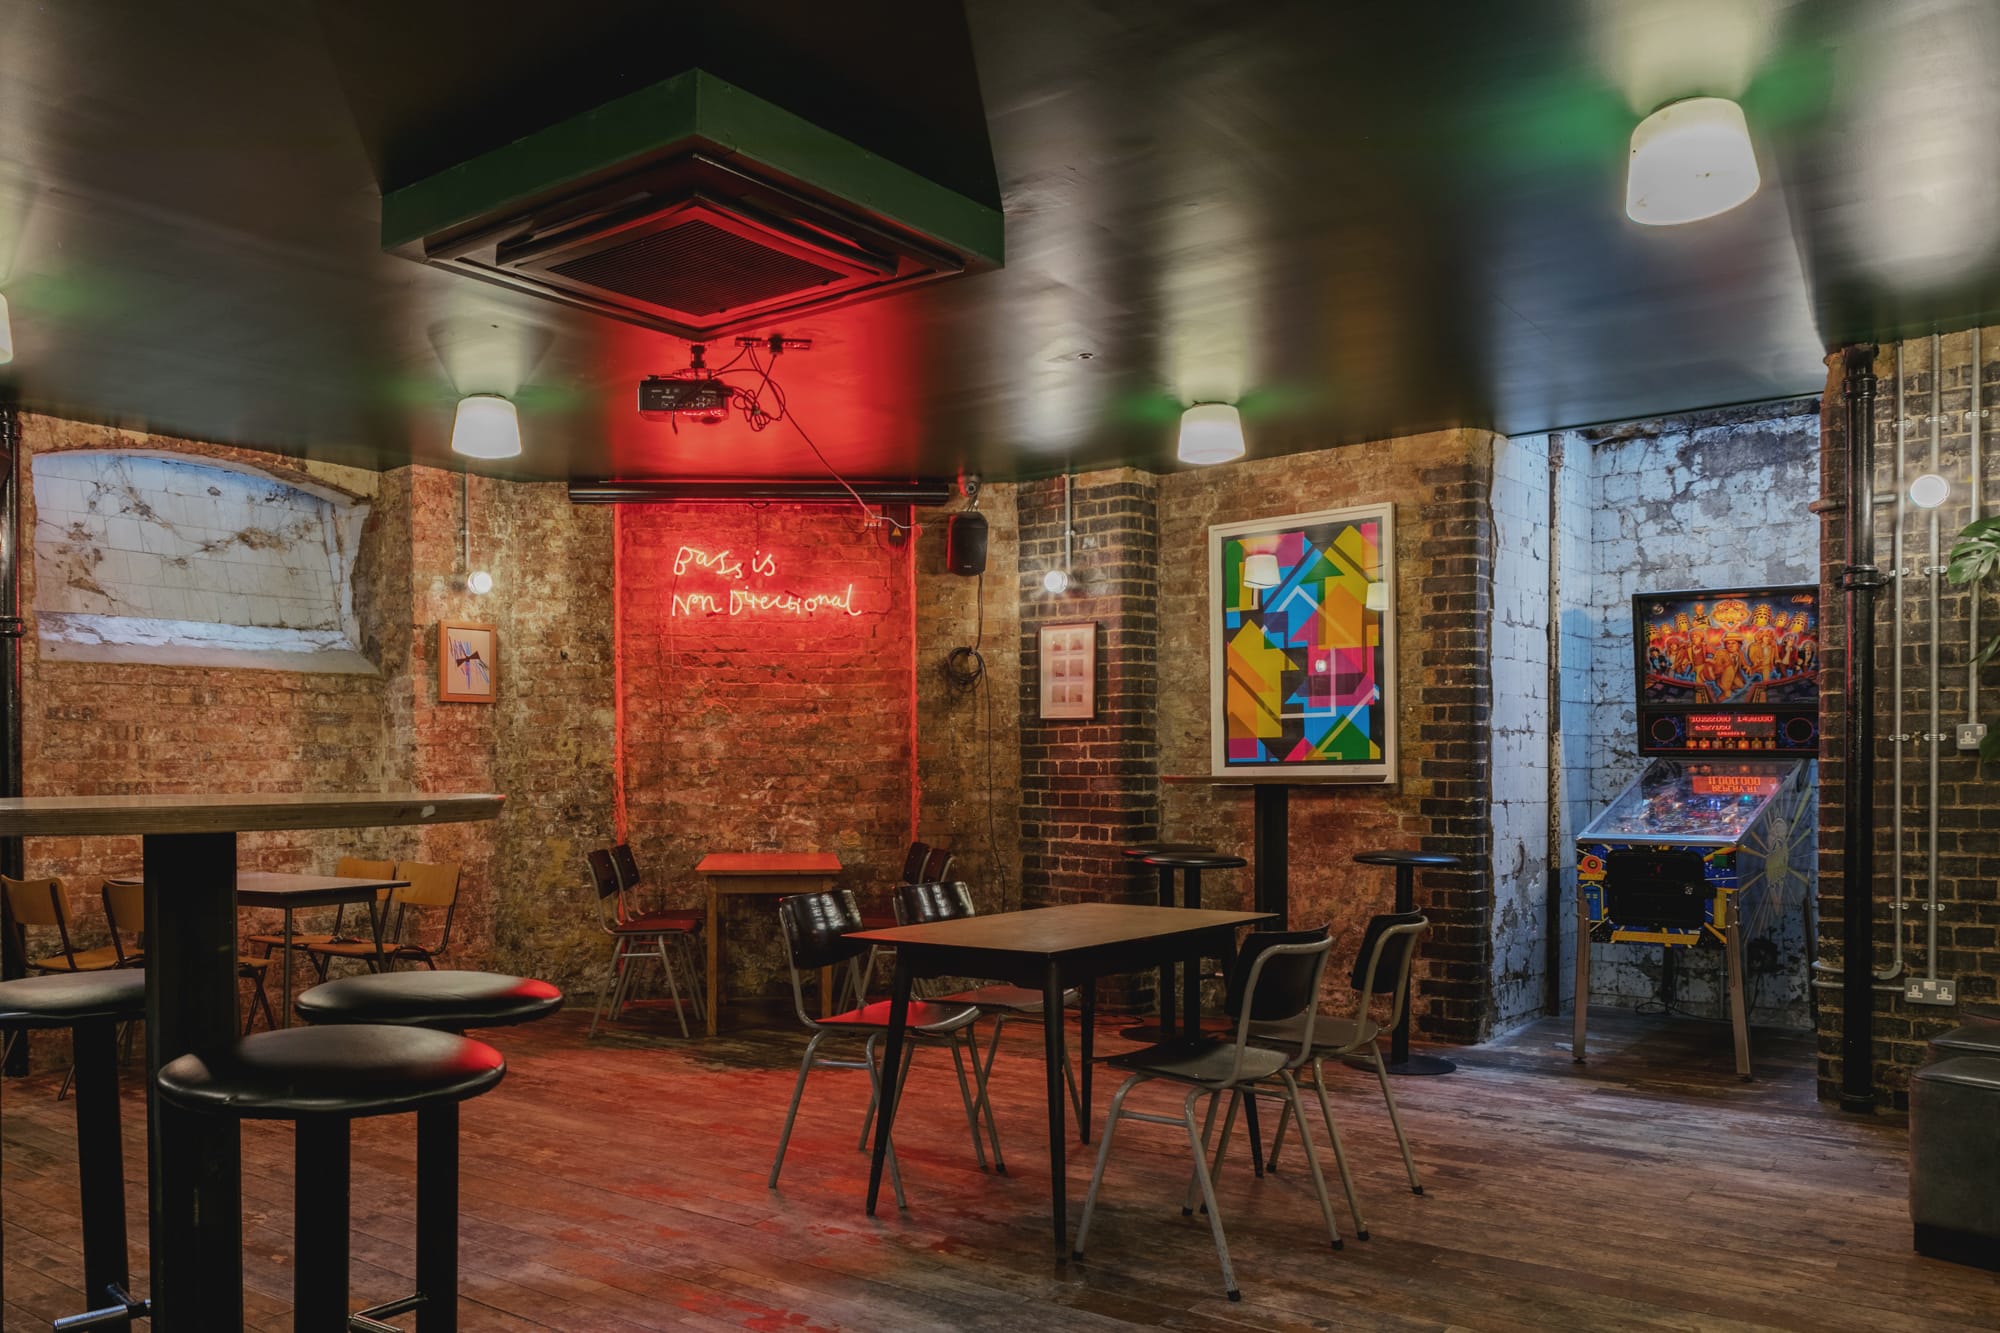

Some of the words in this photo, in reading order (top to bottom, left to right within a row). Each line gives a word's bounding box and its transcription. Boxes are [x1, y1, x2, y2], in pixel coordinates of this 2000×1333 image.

[673, 546, 742, 579] Bass
[752, 550, 776, 577] is
[672, 593, 722, 616] Non
[730, 585, 862, 616] Directional
